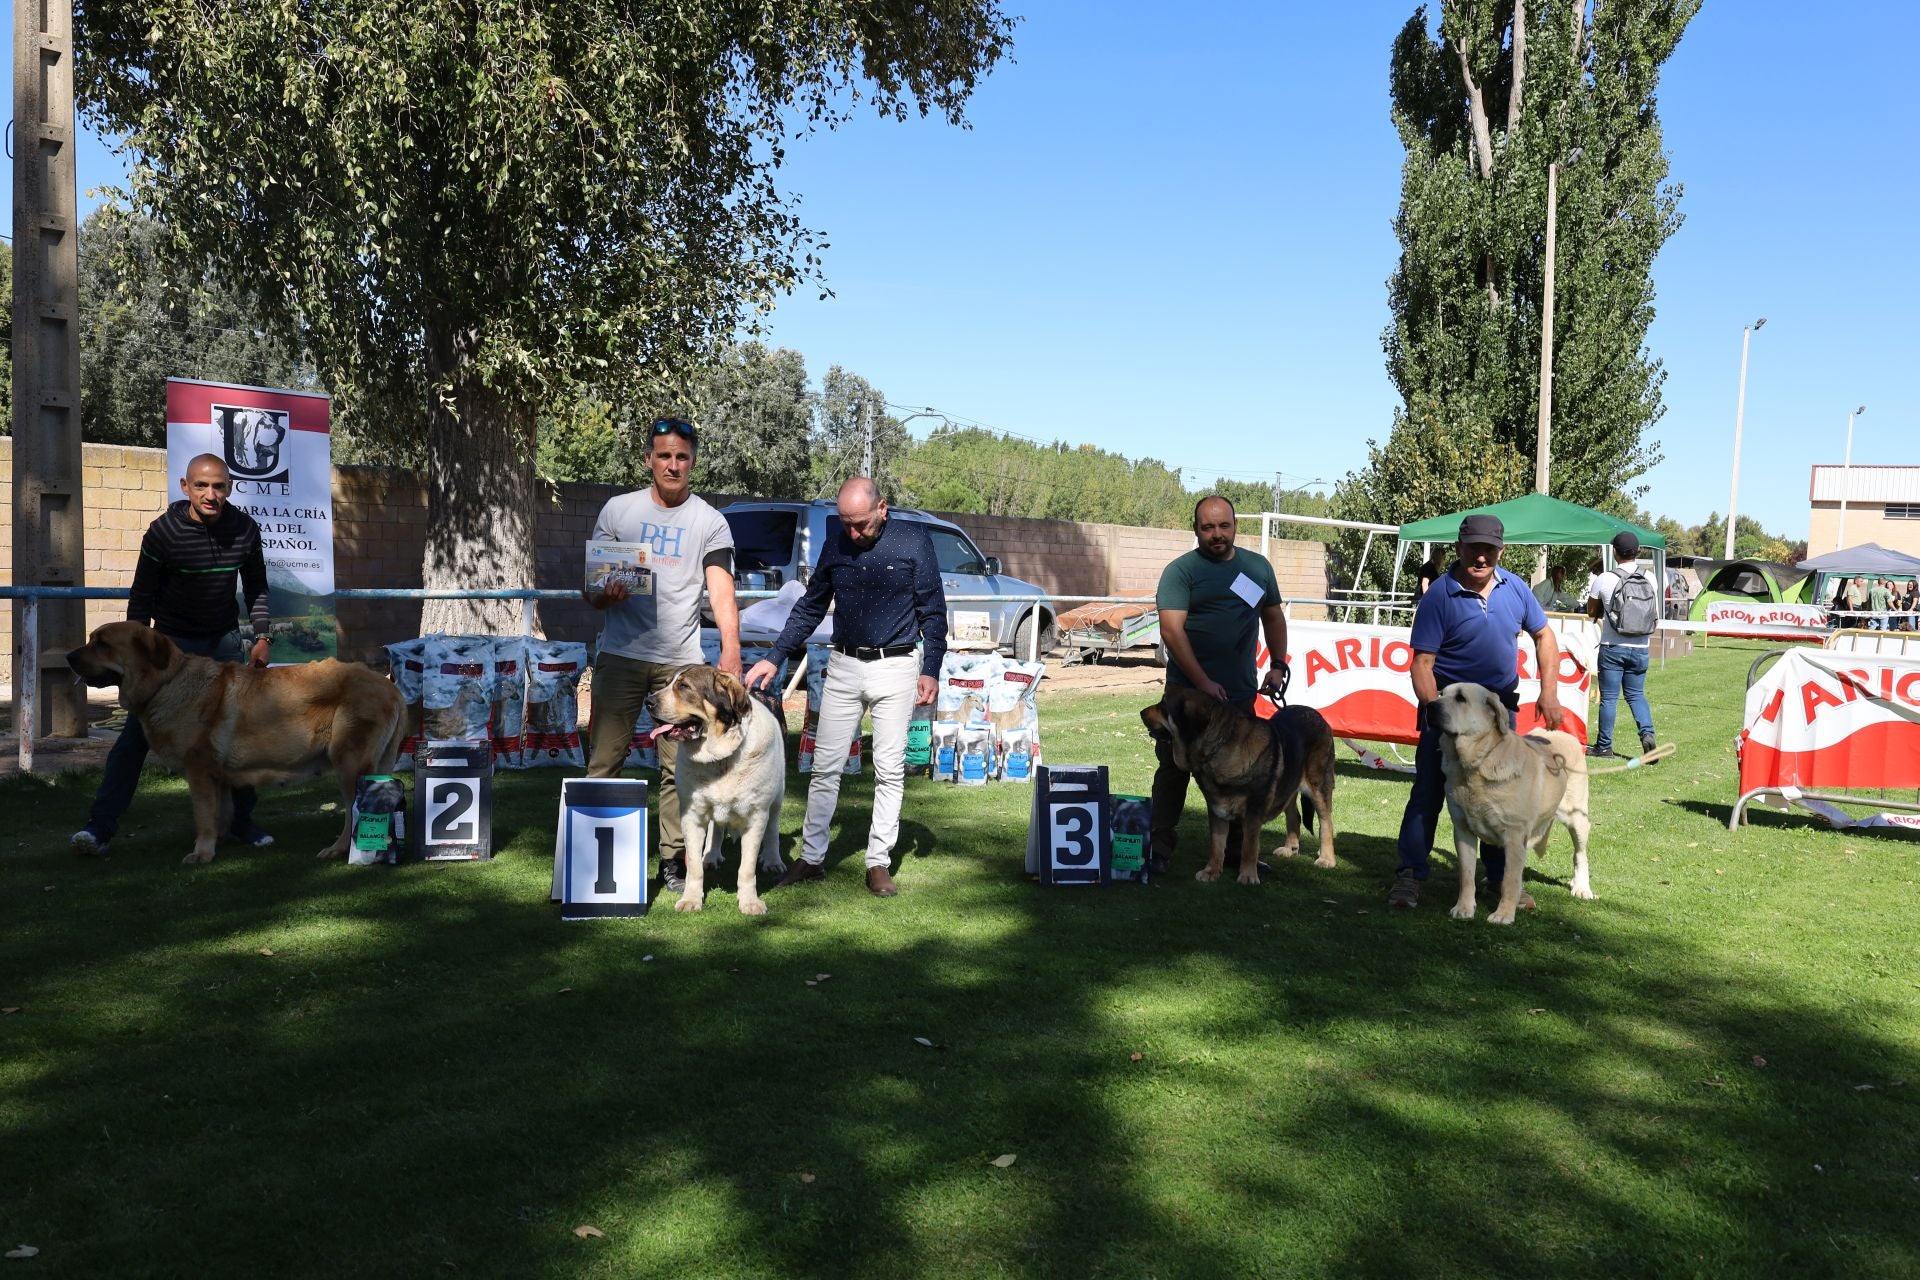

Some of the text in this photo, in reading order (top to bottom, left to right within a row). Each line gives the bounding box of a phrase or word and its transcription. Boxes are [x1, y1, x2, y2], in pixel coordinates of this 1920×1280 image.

[258, 522, 306, 535] RA DEL
[273, 507, 292, 518] LA
[294, 507, 327, 520] CRÍA
[261, 537, 317, 551] SPAÑOL
[1711, 609, 1755, 624] ARION
[1759, 611, 1805, 627] ARION
[1305, 637, 1415, 688] ARIO
[1801, 668, 1920, 726] ARIO
[432, 782, 474, 840] 2
[1055, 806, 1095, 866] 3
[594, 826, 618, 894] 1
